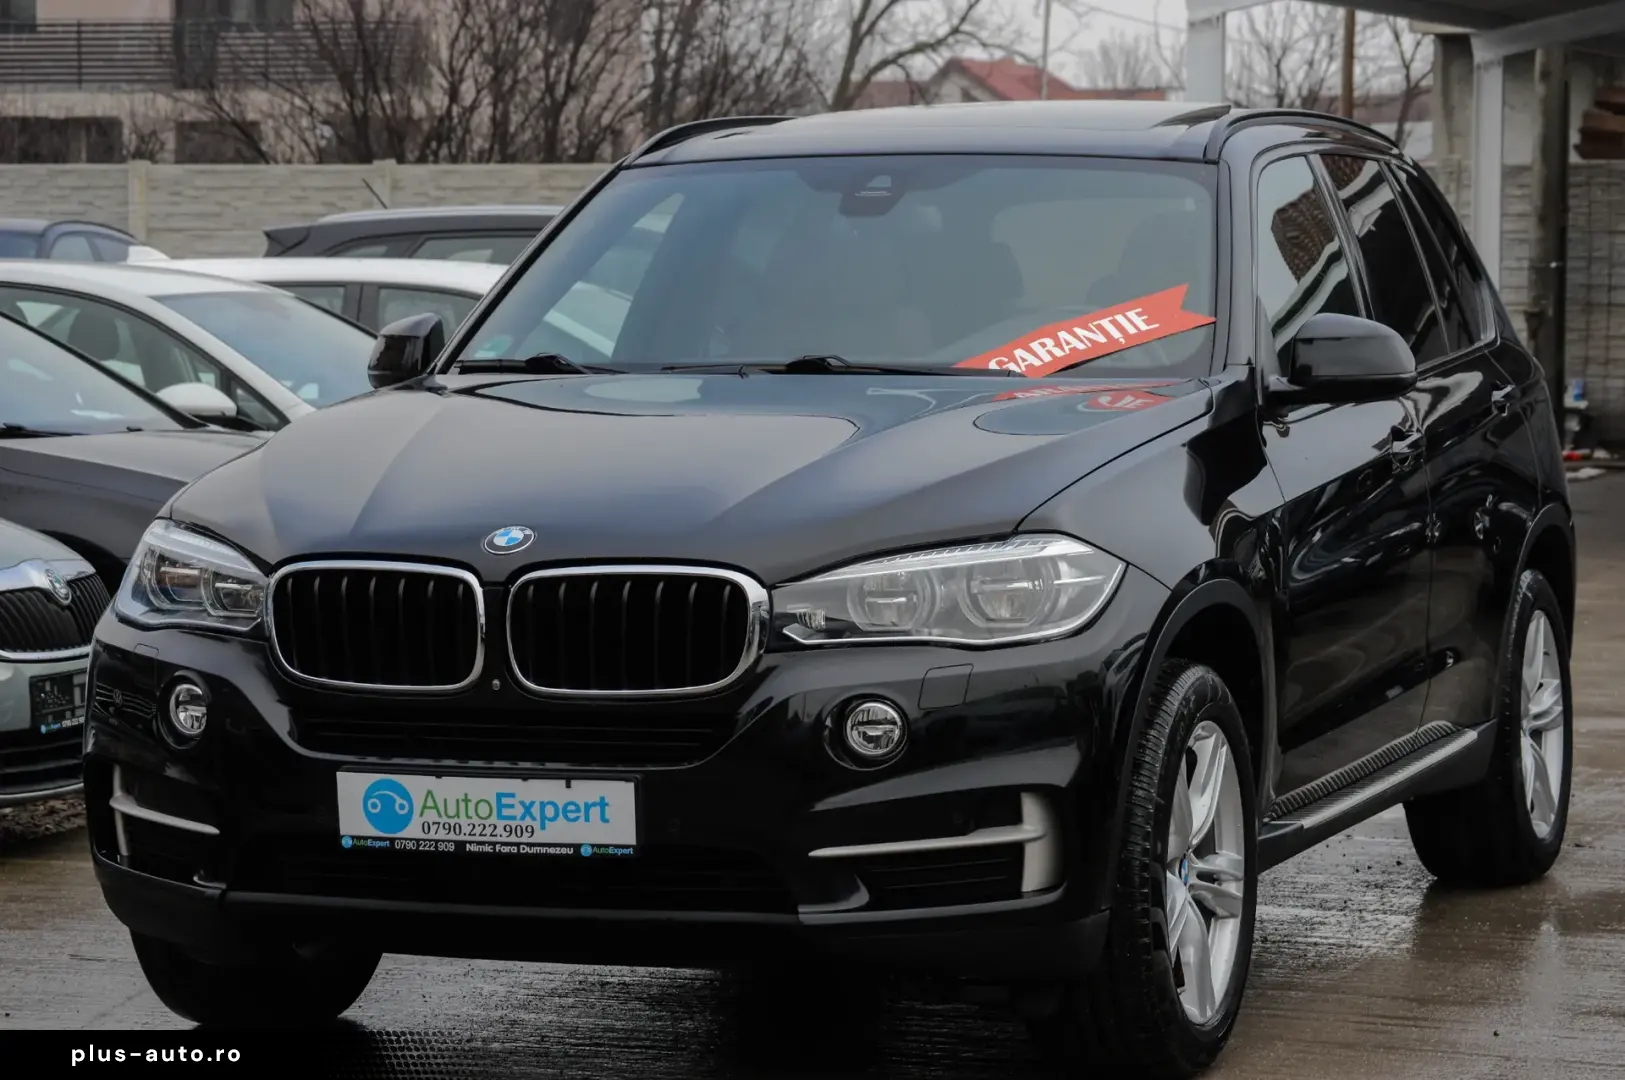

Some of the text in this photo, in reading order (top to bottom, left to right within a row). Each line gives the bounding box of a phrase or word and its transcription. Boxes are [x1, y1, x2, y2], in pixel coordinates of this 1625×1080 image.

[419, 789, 610, 831] AutoExpert
[421, 820, 535, 839] 0790.222.909
[352, 839, 634, 856] AutoExpert 0790 222 909 Nimic Fara Dumnezeu AutoExpert
